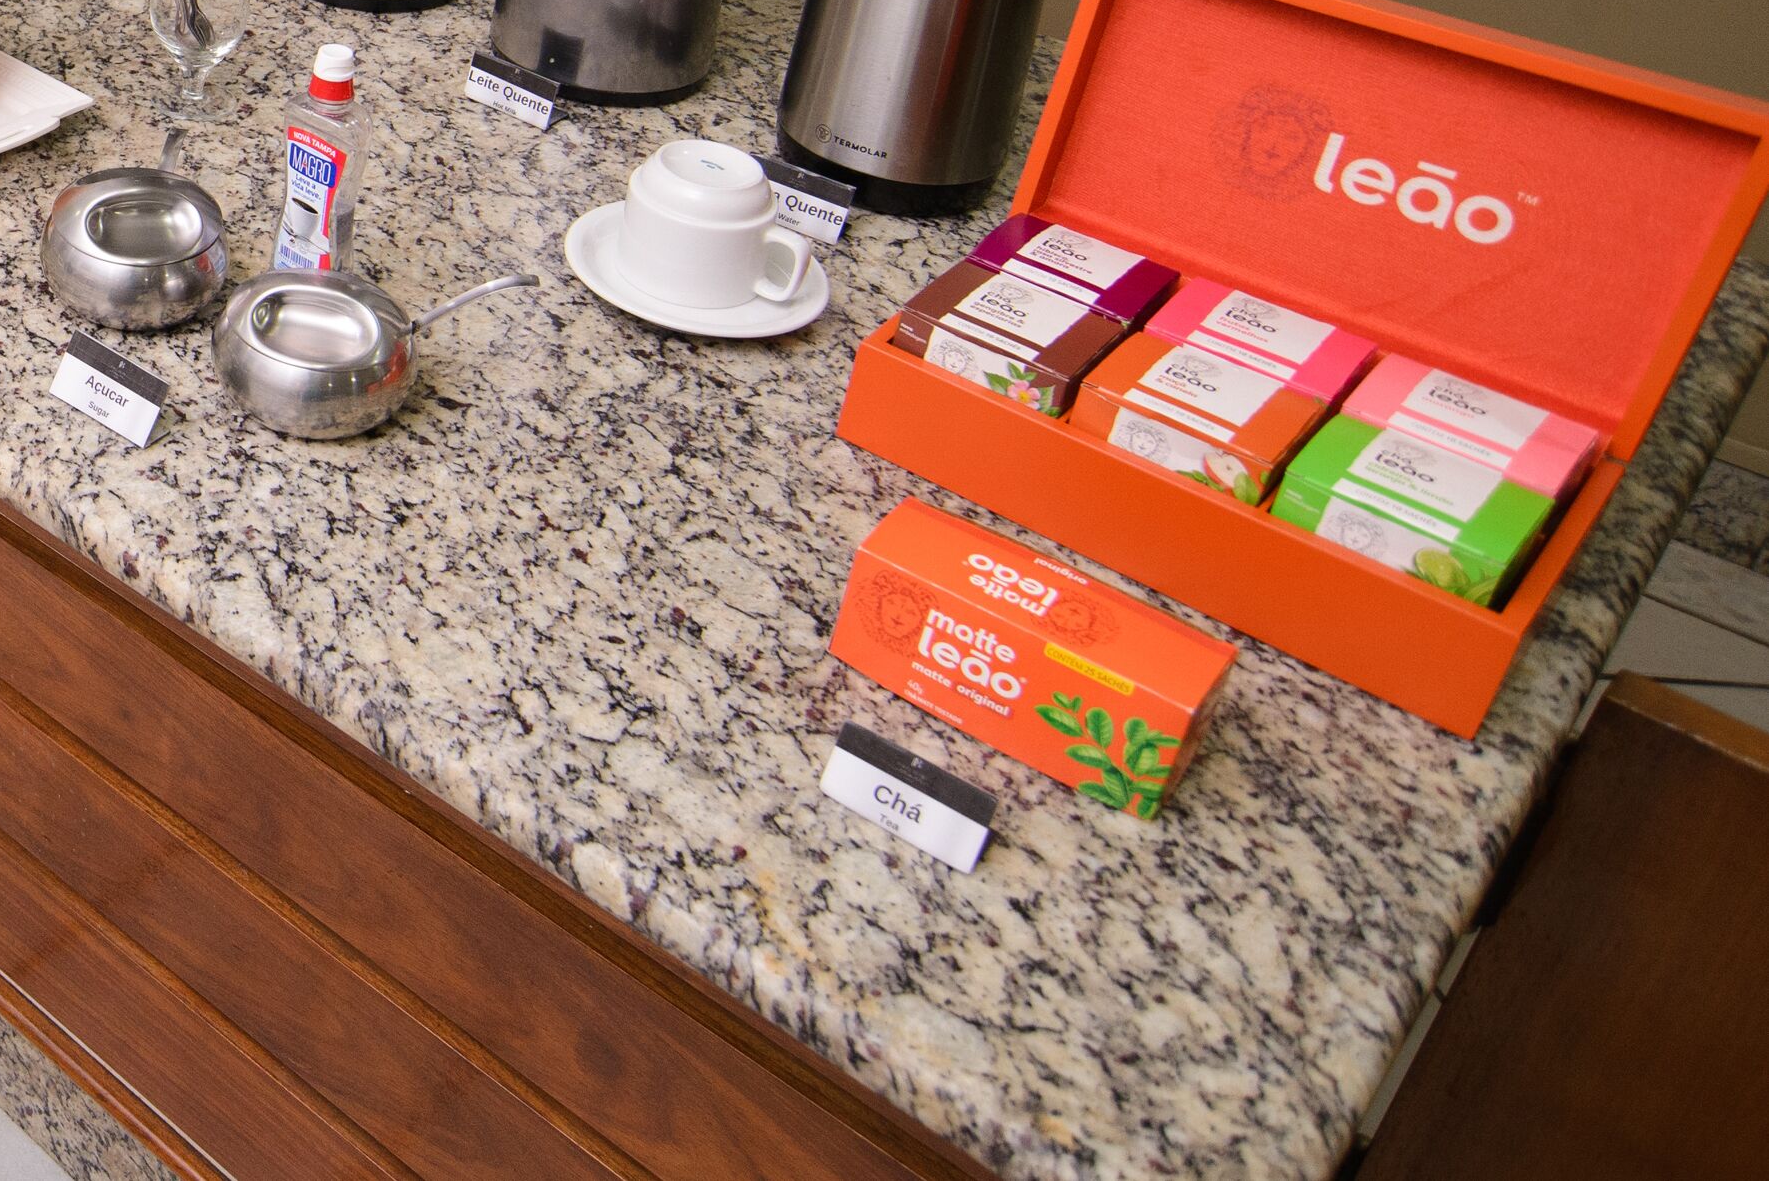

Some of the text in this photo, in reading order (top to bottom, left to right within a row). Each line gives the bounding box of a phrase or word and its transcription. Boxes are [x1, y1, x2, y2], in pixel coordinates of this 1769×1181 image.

[468, 69, 500, 93] Leite
[503, 85, 549, 115] Quente
[293, 131, 336, 158] NOVA TAMPA
[833, 135, 888, 159] TERMOLAR
[292, 145, 332, 185] MAGRO
[778, 212, 801, 227] Water
[785, 194, 844, 227] Quente
[85, 375, 130, 408] Açucar
[88, 401, 110, 419] Sugar
[1033, 557, 1090, 586] original
[968, 573, 1048, 617] matte
[926, 608, 1017, 664] matte
[911, 660, 1011, 717] matte original
[873, 784, 923, 824] Chá
[880, 813, 900, 832] Tea
